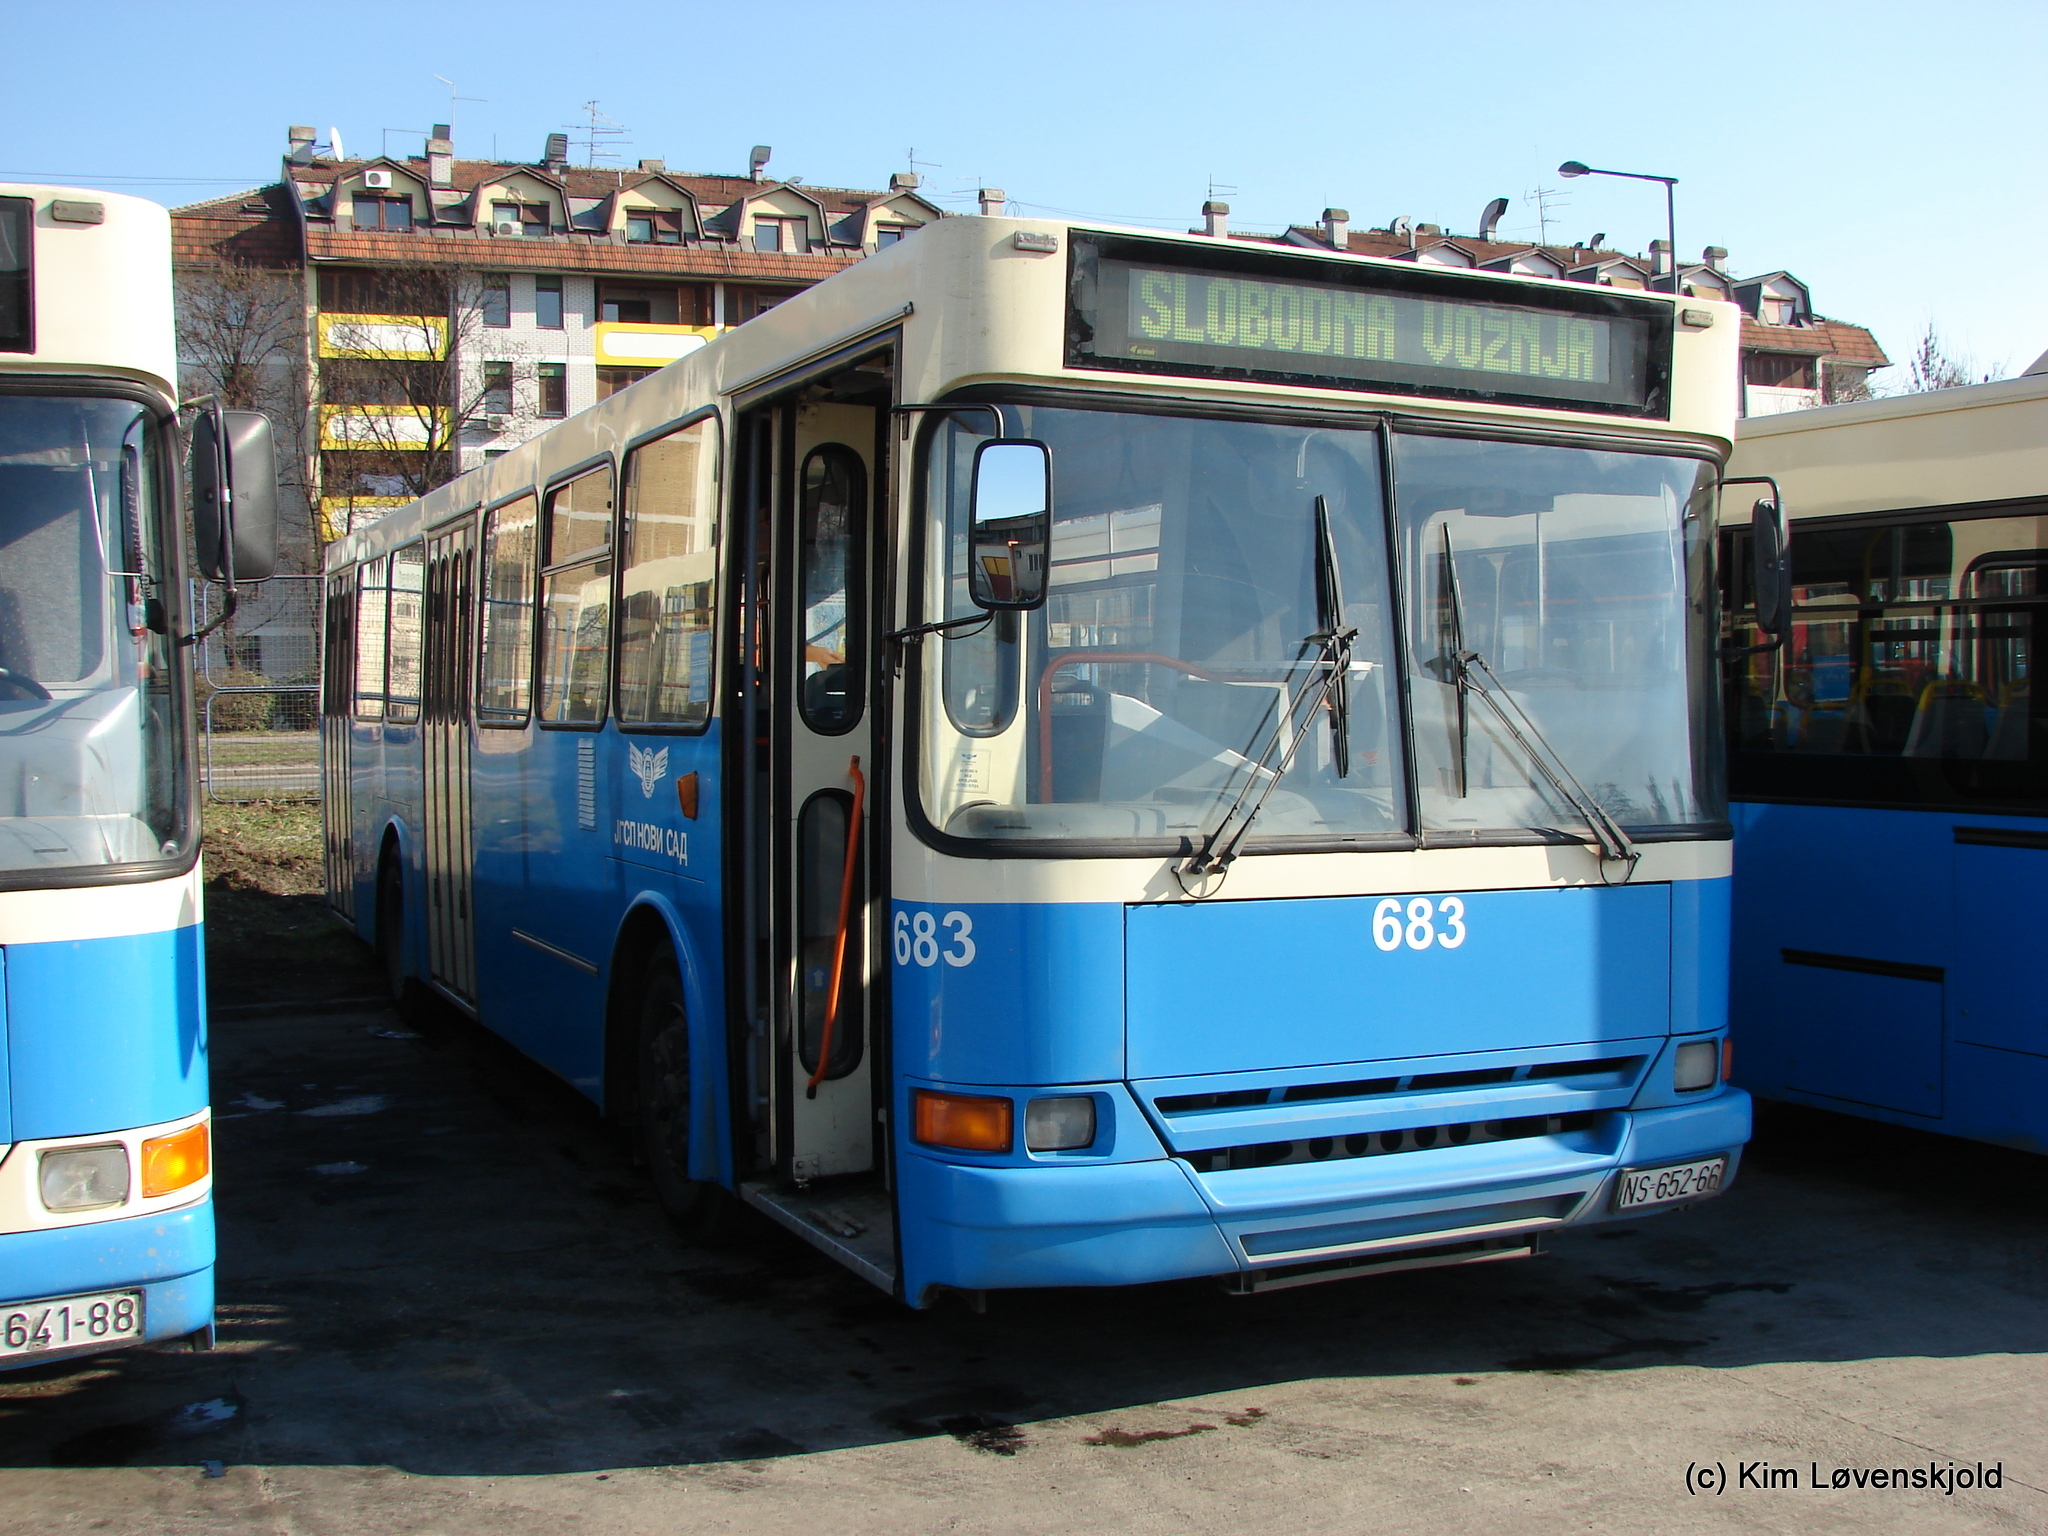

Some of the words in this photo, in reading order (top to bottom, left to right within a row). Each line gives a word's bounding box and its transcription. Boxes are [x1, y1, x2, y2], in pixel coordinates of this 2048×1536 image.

[1140, 270, 1395, 360] SLOBODNA
[637, 822, 664, 854] НОВИ
[666, 828, 688, 867] САД
[893, 910, 976, 968] 683
[1372, 896, 1466, 952] 683
